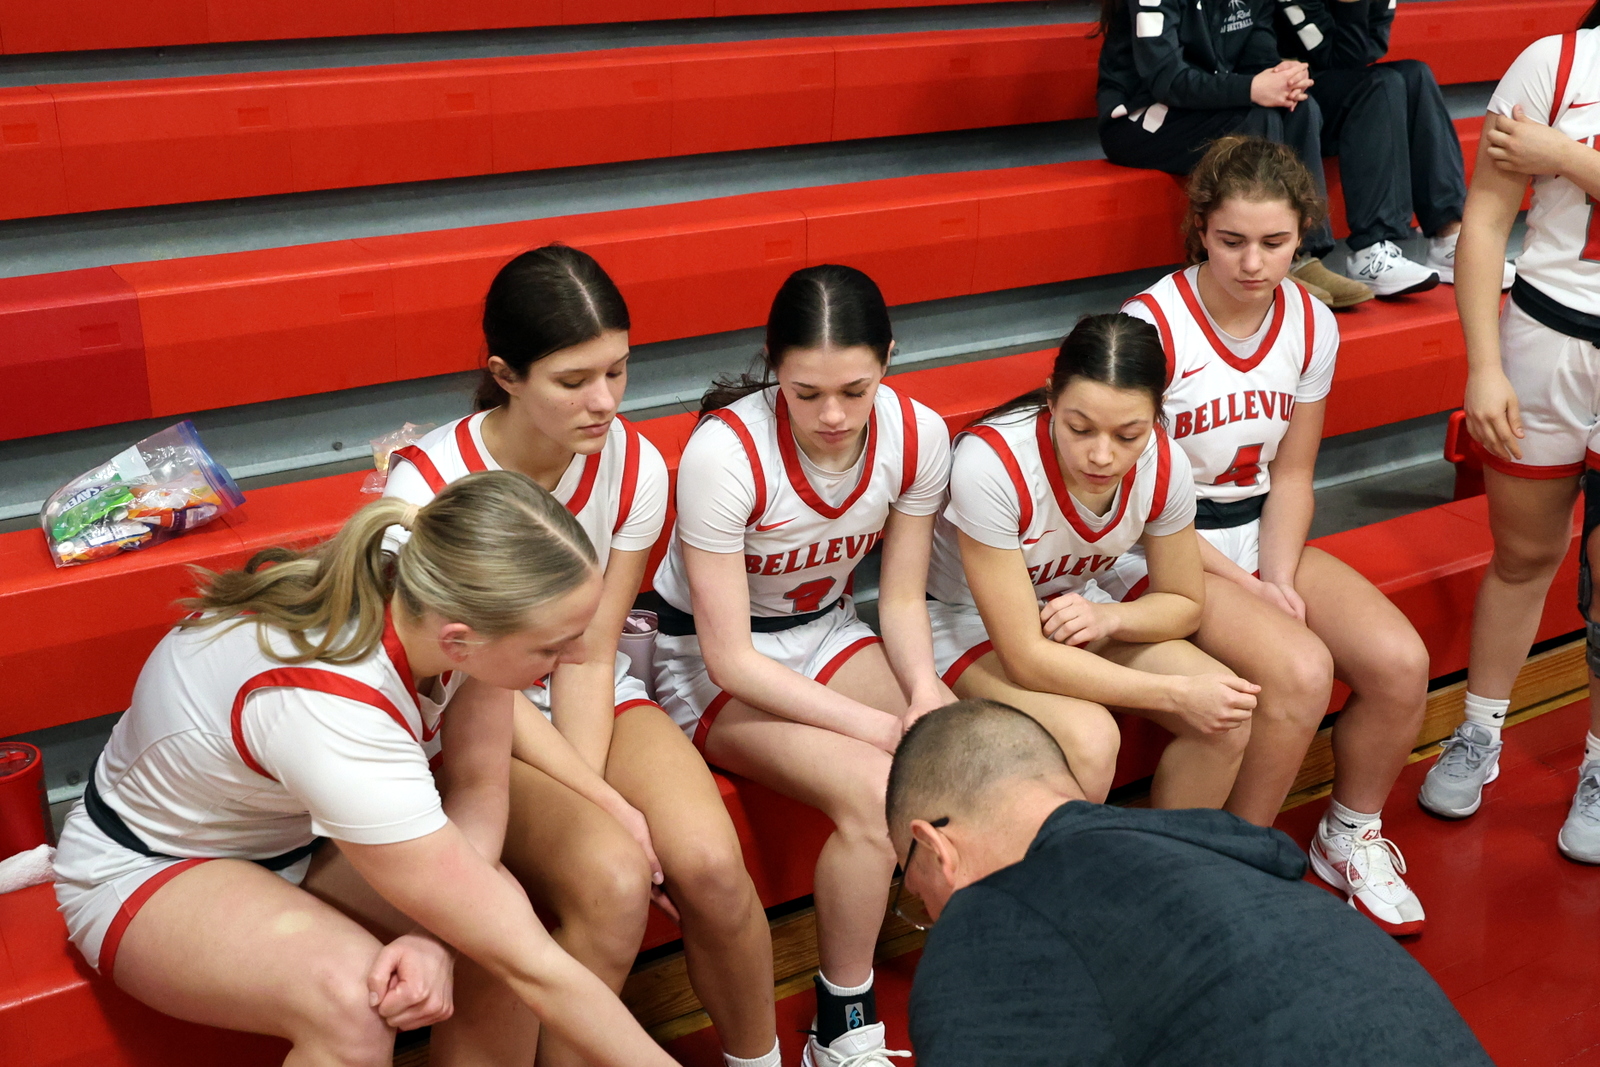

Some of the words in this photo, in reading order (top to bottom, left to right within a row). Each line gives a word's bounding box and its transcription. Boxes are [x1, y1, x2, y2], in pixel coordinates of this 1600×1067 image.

[1173, 389, 1296, 440] BELLEVU
[1212, 442, 1264, 487] 4
[1027, 554, 1120, 587] ELLEV
